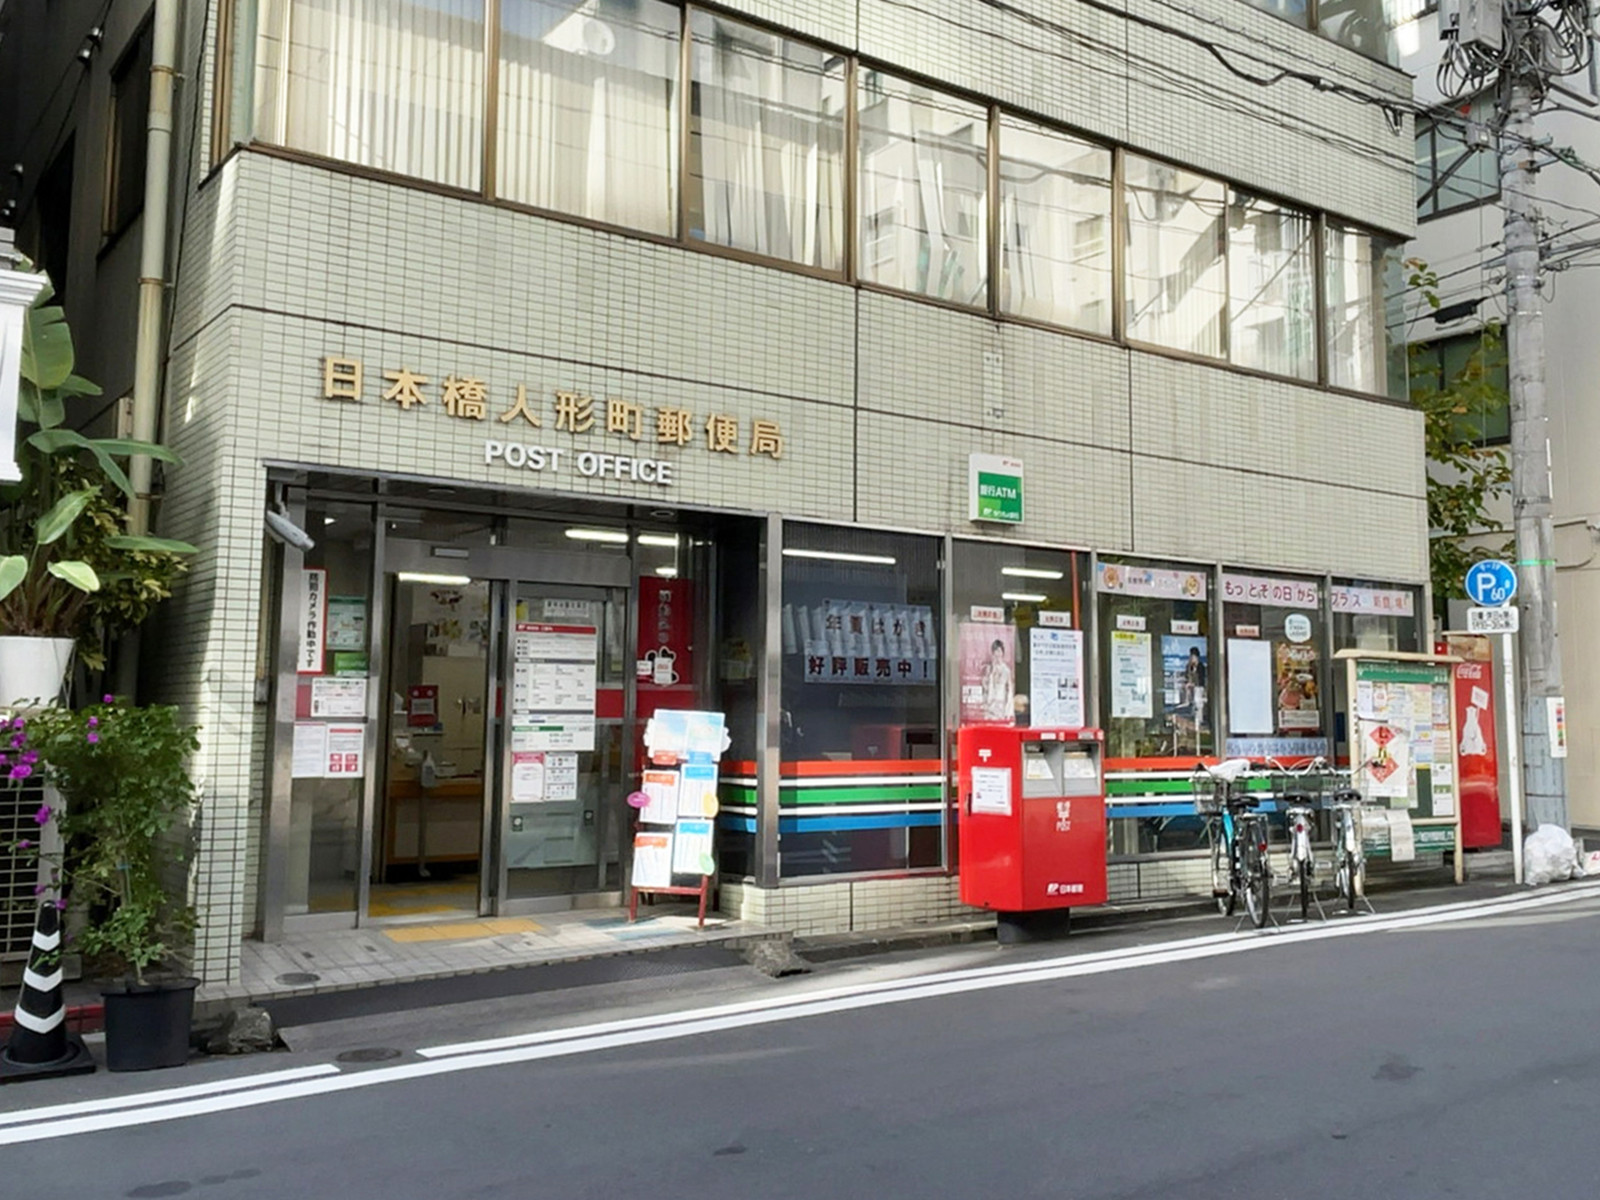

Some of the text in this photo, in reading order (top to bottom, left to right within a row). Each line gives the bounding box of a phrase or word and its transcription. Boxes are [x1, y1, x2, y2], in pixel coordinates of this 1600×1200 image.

[322, 356, 785, 460] 日本橋人形町郵便局
[485, 439, 673, 486] POST OFFICE
[1477, 572, 1497, 602] P
[1491, 587, 1506, 601] 60
[825, 613, 927, 638] 年賀はがき
